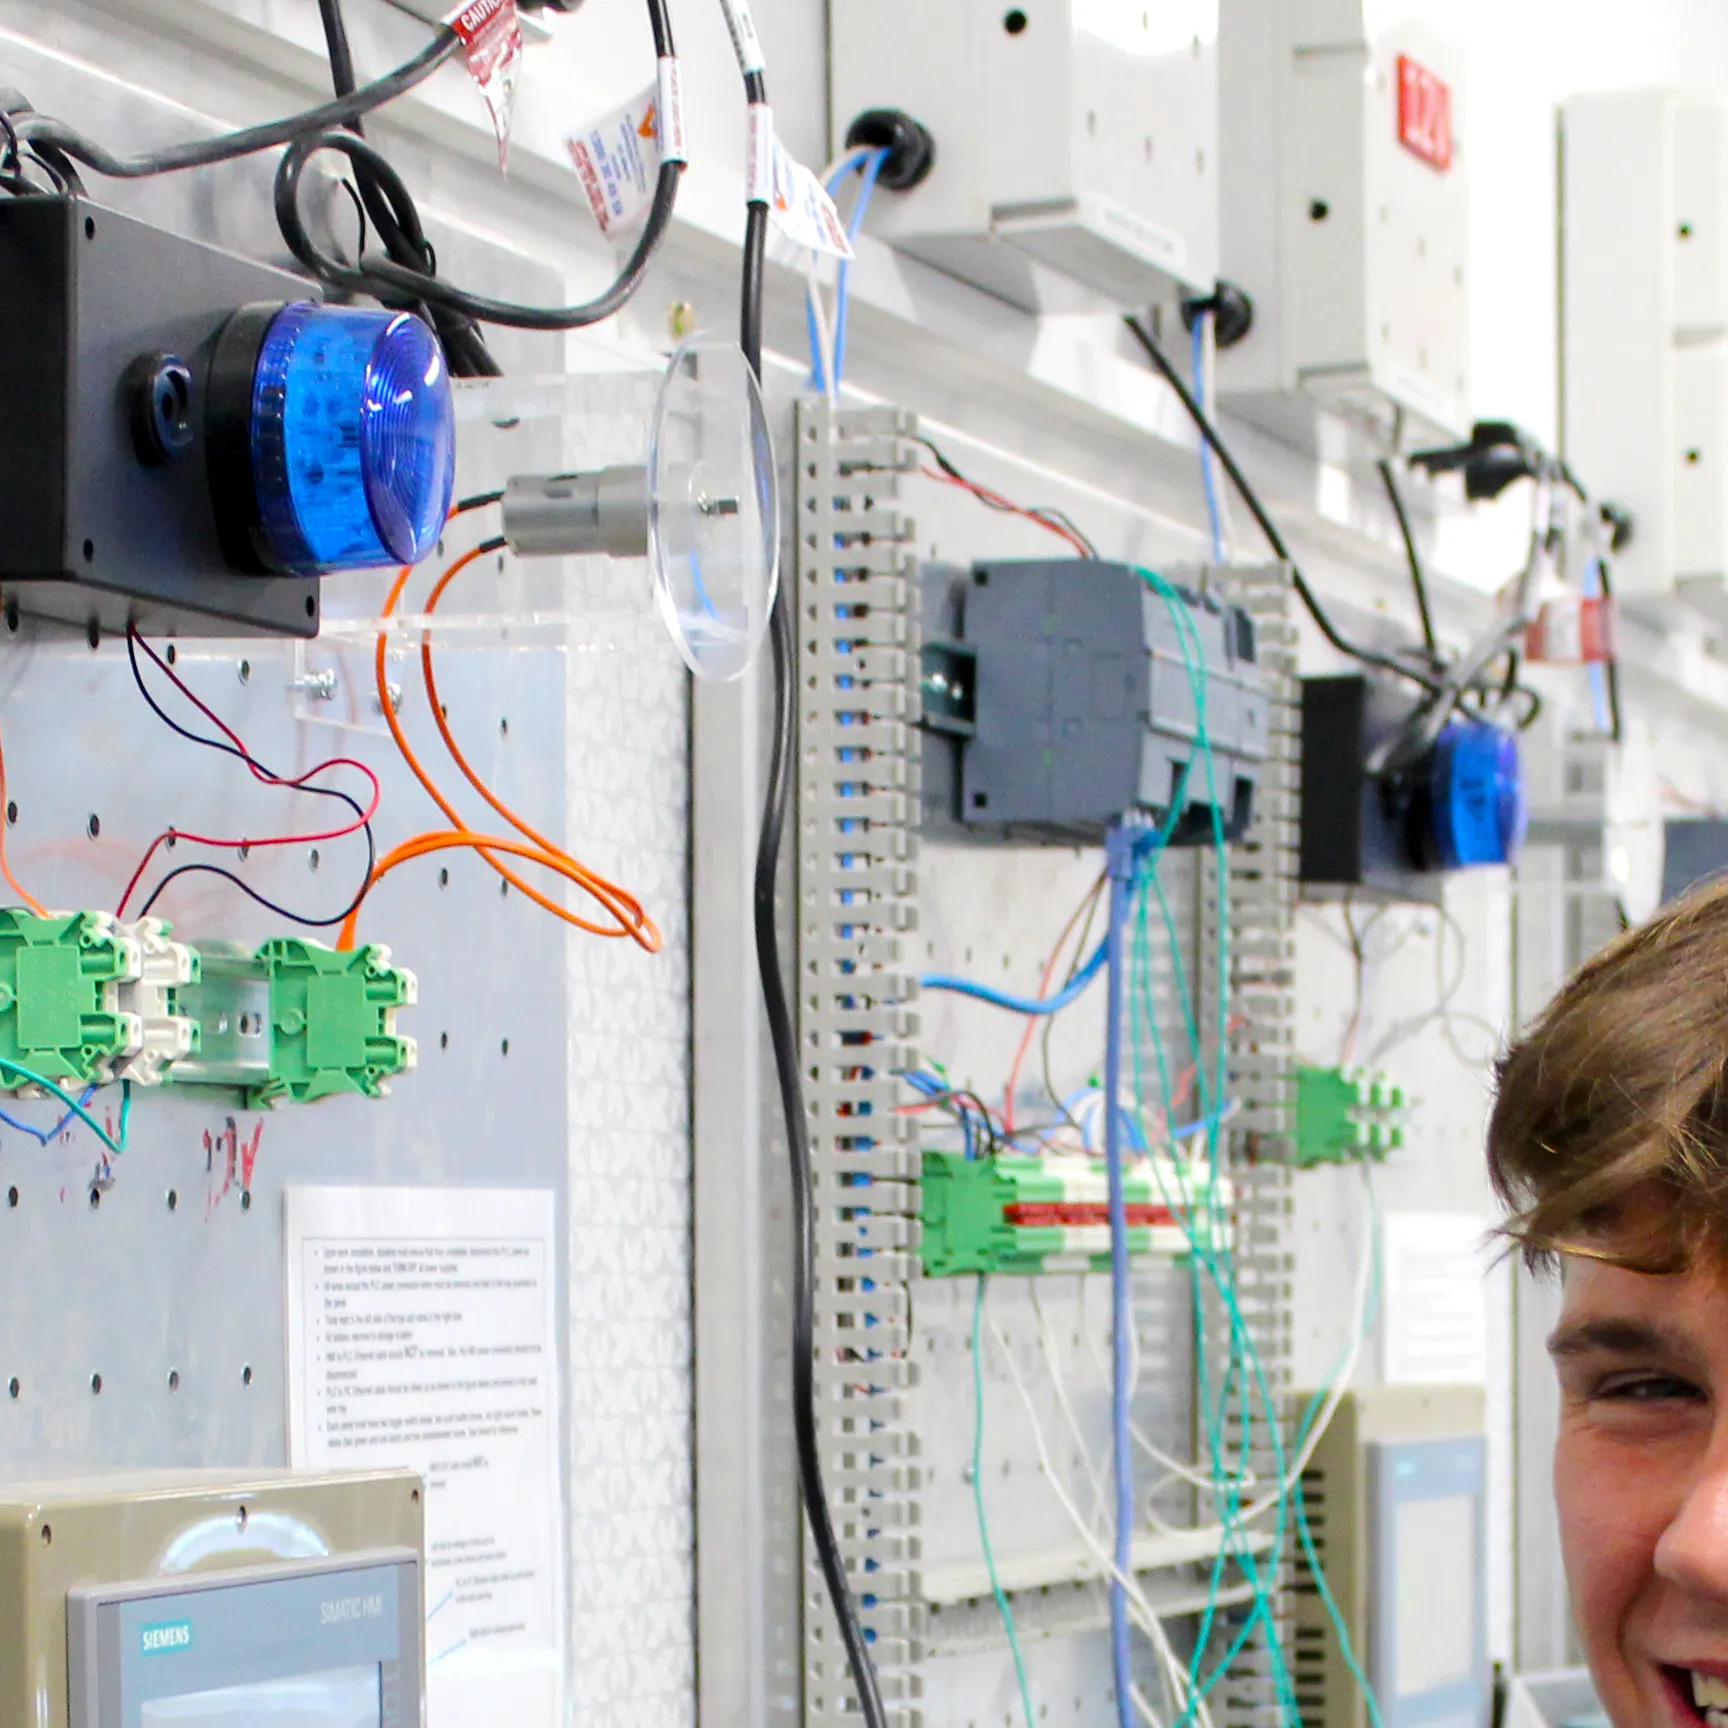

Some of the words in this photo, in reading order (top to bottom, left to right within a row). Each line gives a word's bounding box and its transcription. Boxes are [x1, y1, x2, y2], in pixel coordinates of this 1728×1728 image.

[321, 1598, 360, 1624] SIMATIC
[362, 1595, 383, 1617] HMI
[142, 1625, 190, 1650] SIEMENS
